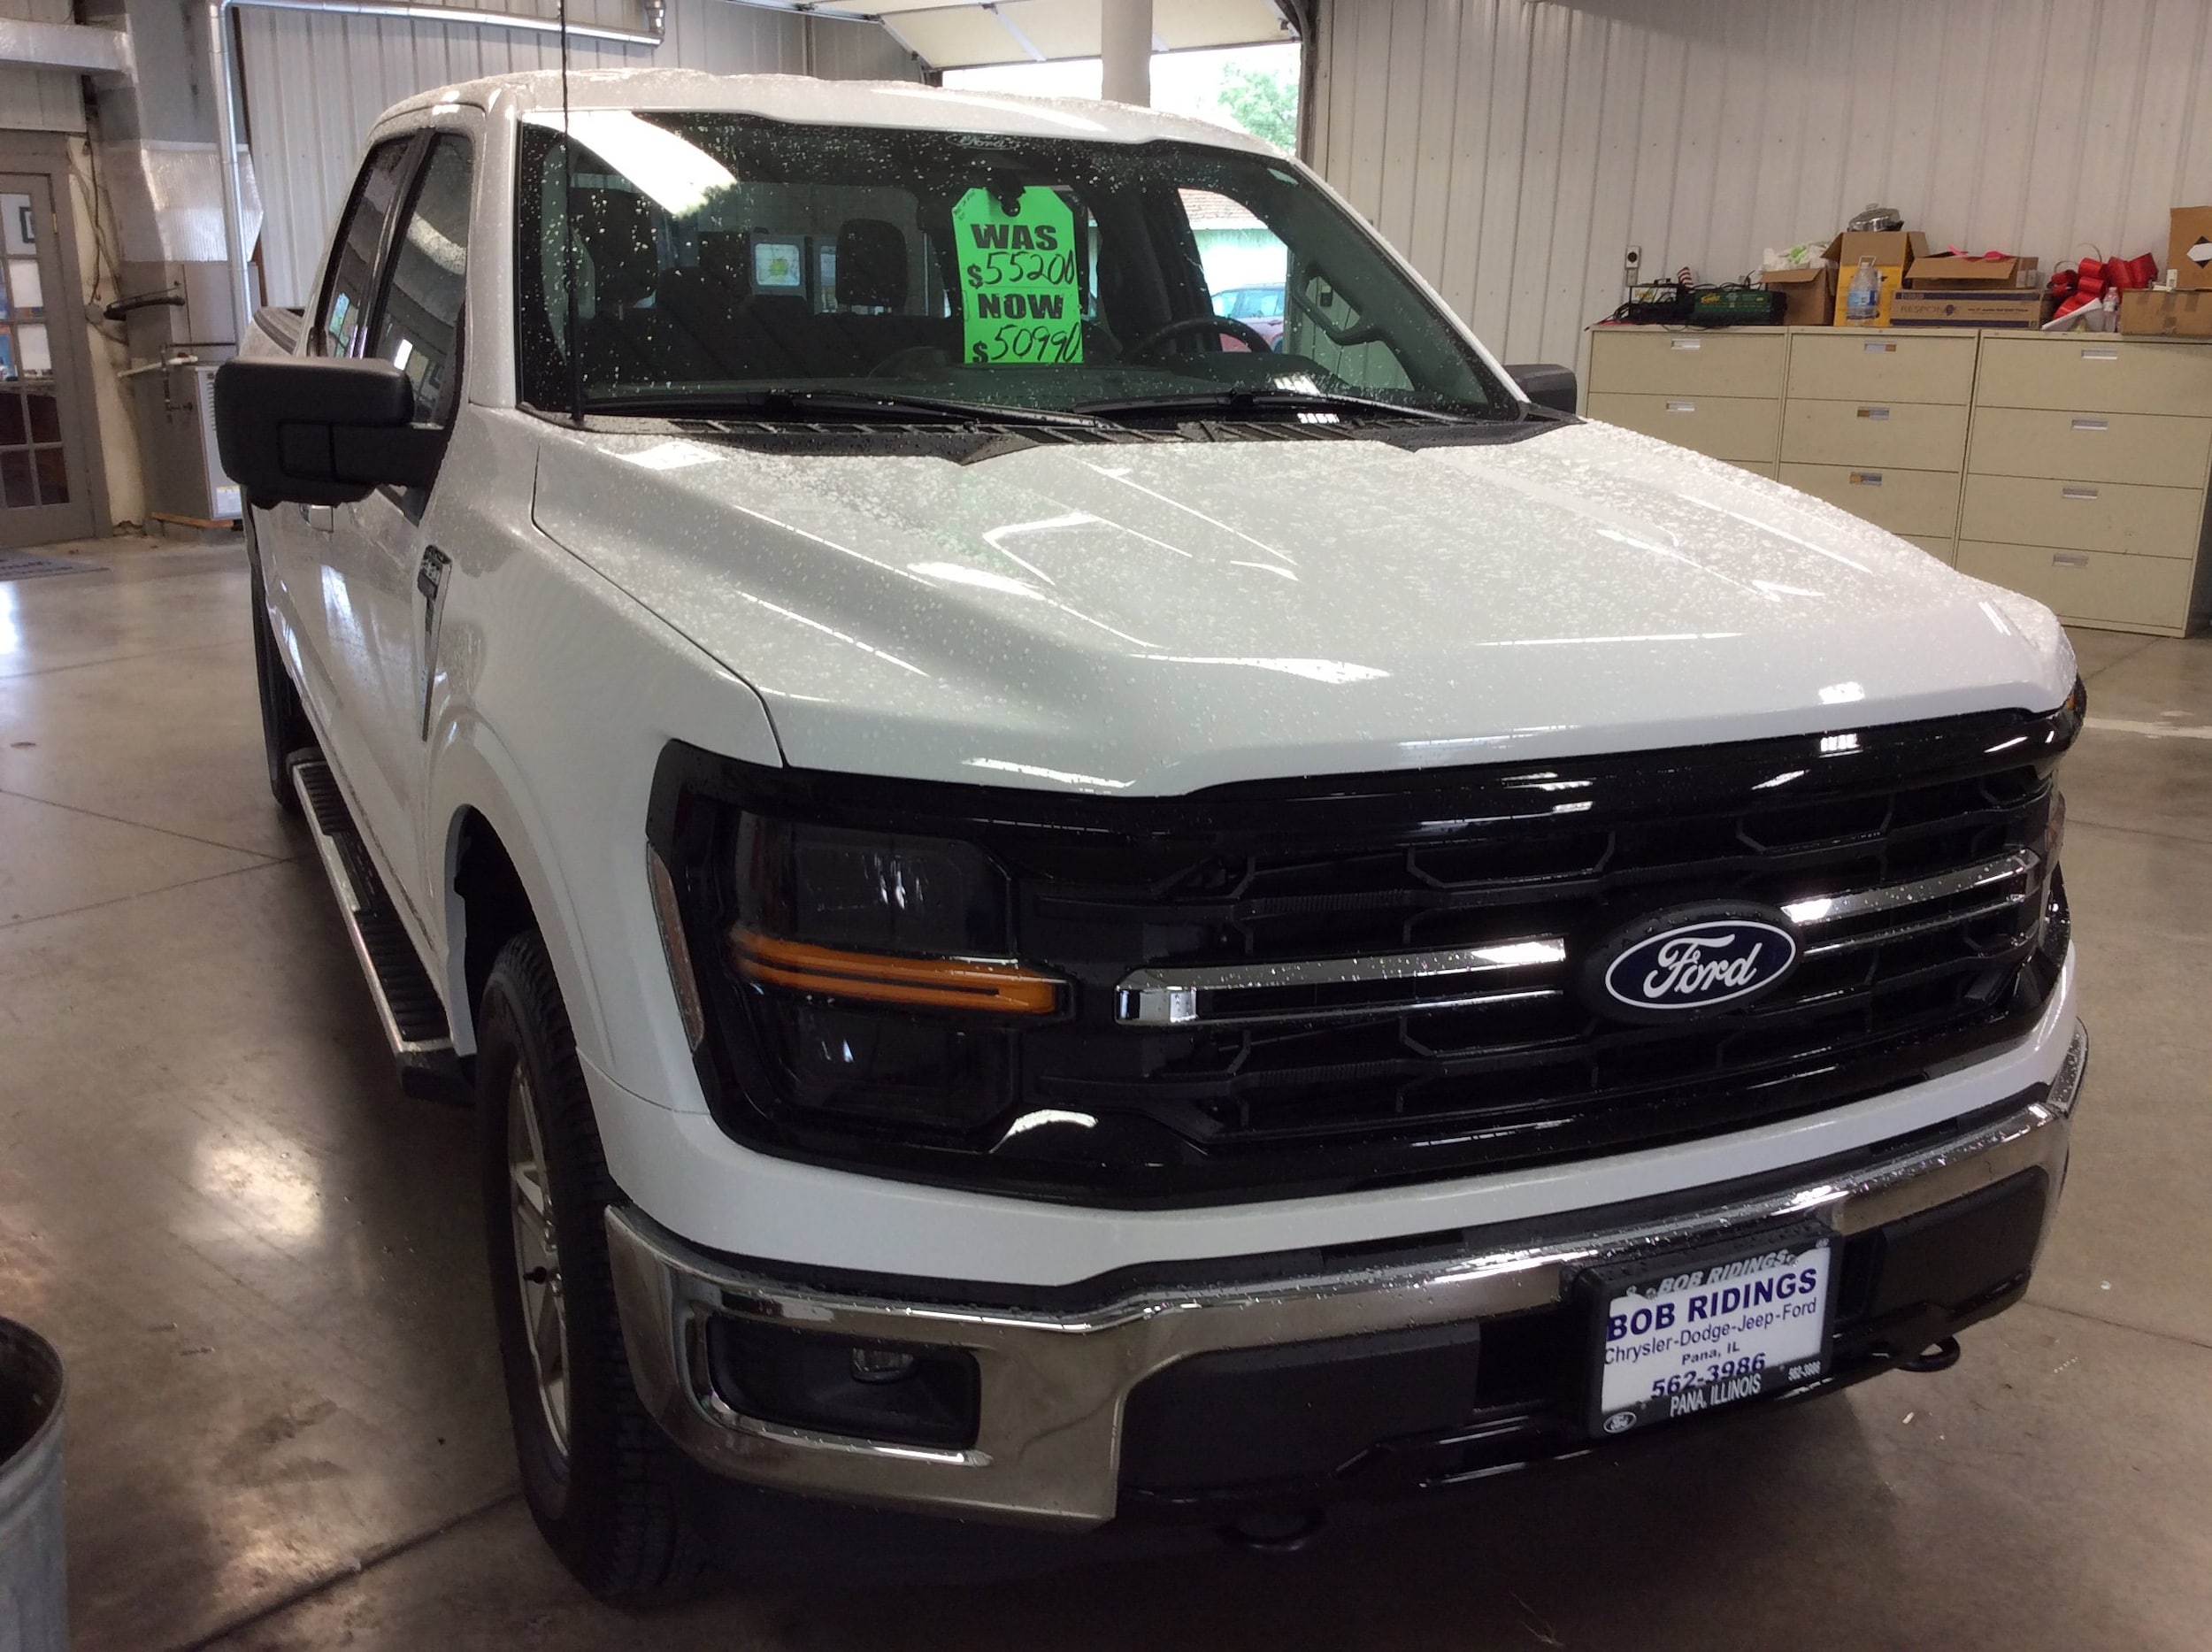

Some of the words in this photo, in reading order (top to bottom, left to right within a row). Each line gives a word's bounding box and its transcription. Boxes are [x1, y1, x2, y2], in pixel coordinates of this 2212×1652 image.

[970, 224, 1058, 251] WAS
[978, 293, 1064, 319] NOW
[1643, 934, 1763, 998] Ford
[1657, 1271, 1703, 1295] BOB
[1706, 1249, 1789, 1286] RIDINGS
[1607, 1302, 1675, 1342] BOB
[1687, 1267, 1817, 1323] RIDINGS
[1727, 1341, 1740, 1353] IL
[1650, 1353, 1766, 1399] 562-3986
[1709, 1373, 1762, 1406] ILLINOIS
